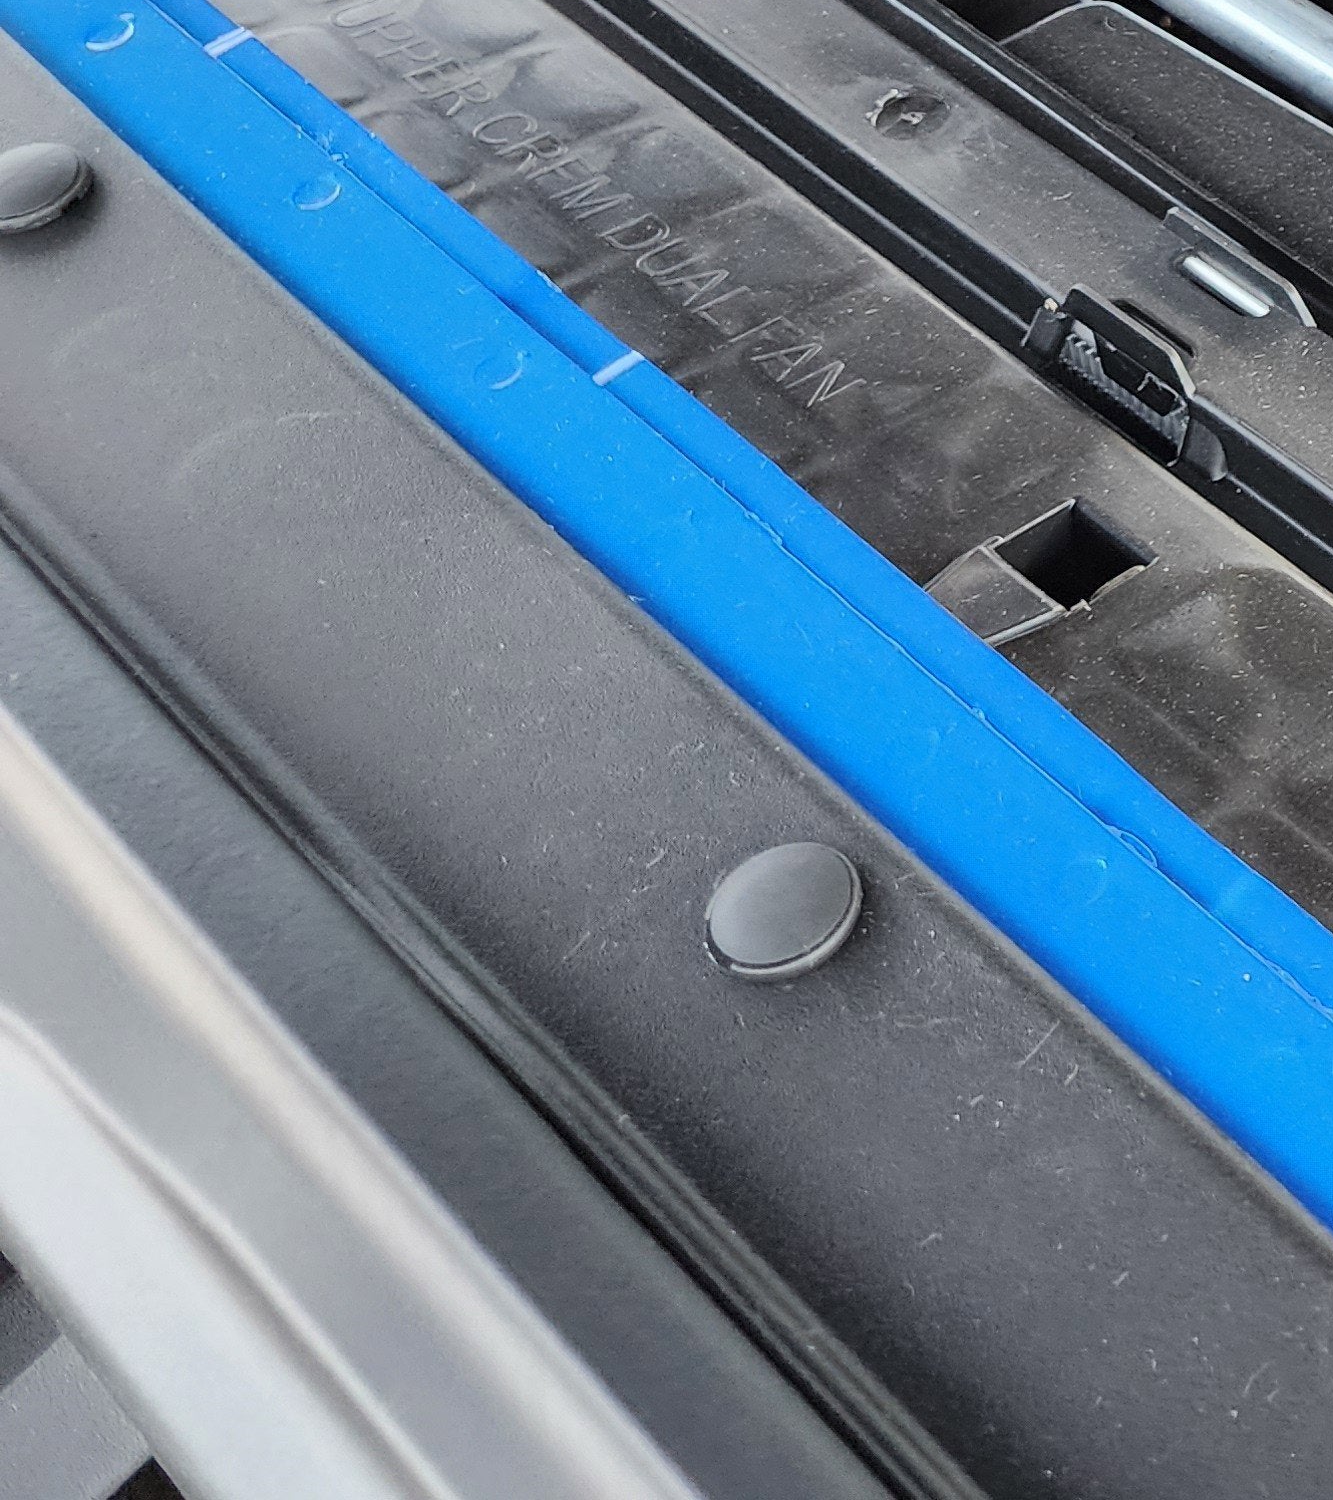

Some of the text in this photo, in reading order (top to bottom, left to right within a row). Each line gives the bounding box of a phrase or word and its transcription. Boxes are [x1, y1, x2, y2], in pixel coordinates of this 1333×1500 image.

[472, 112, 635, 221] CRFM
[597, 212, 751, 328] DUAL
[726, 315, 867, 408] FAN
